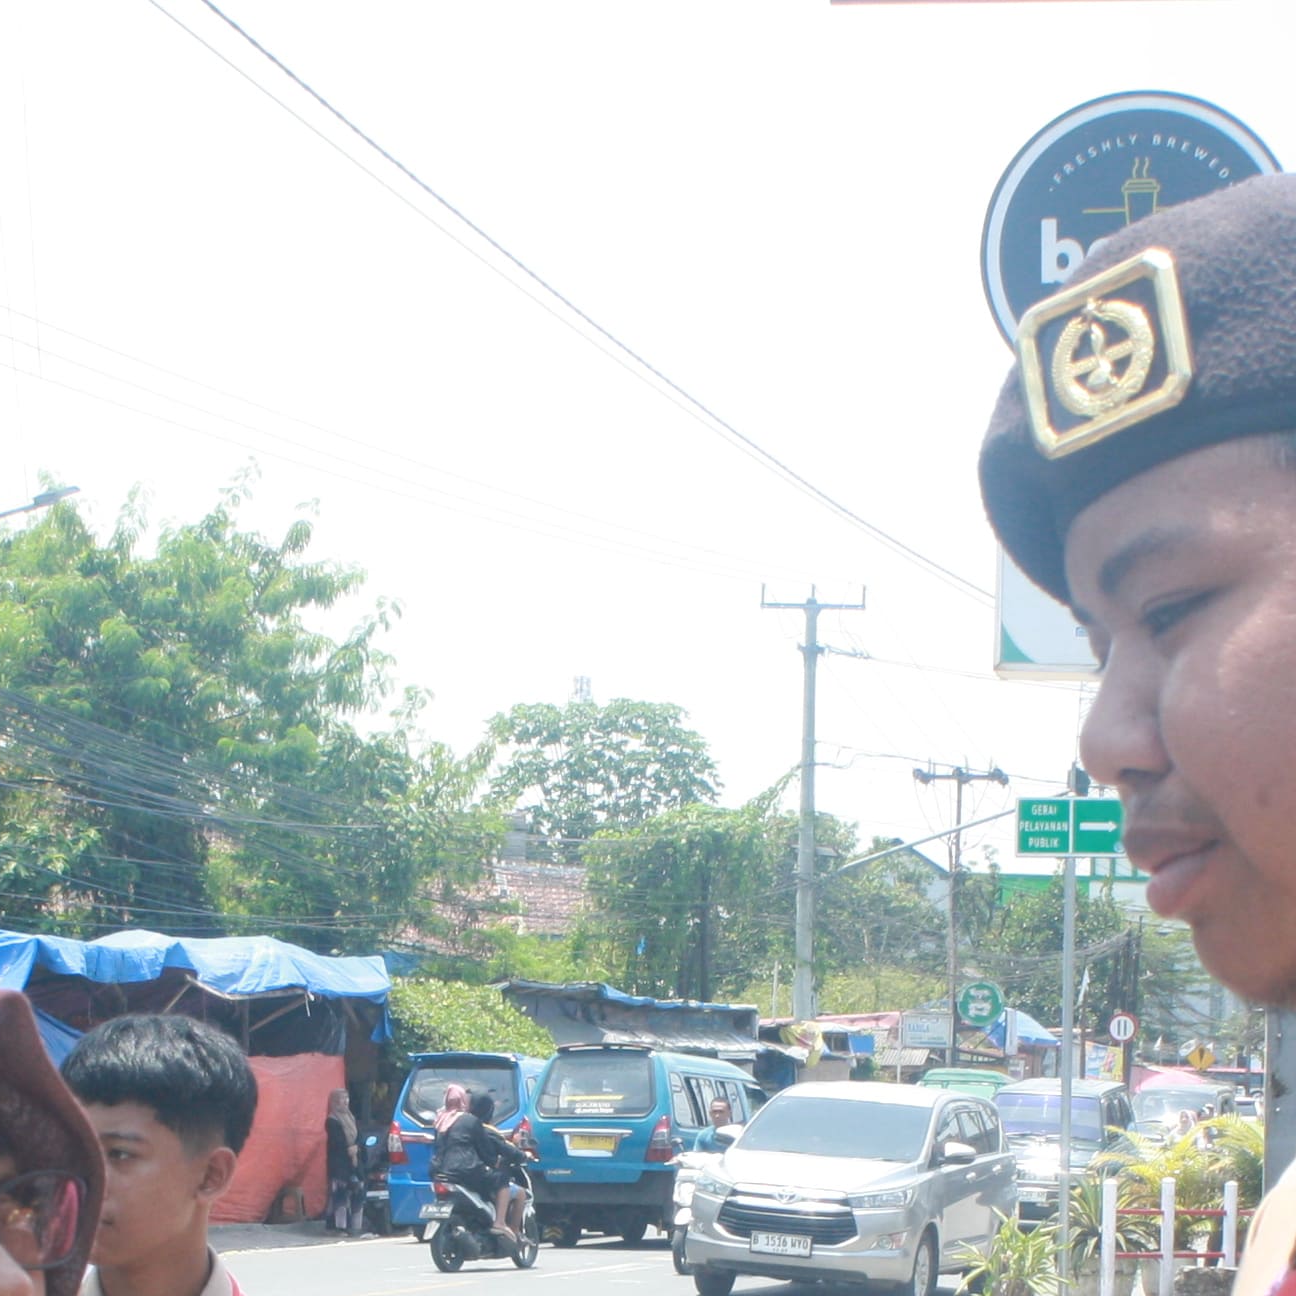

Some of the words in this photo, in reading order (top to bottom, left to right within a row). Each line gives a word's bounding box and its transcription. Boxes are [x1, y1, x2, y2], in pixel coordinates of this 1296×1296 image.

[1053, 134, 1138, 184] FRESHLY
[1152, 134, 1230, 179] BREWED
[1031, 804, 1057, 816] GERAI
[1019, 821, 1068, 832] PELAYANAN
[1028, 837, 1060, 849] PUBLIK
